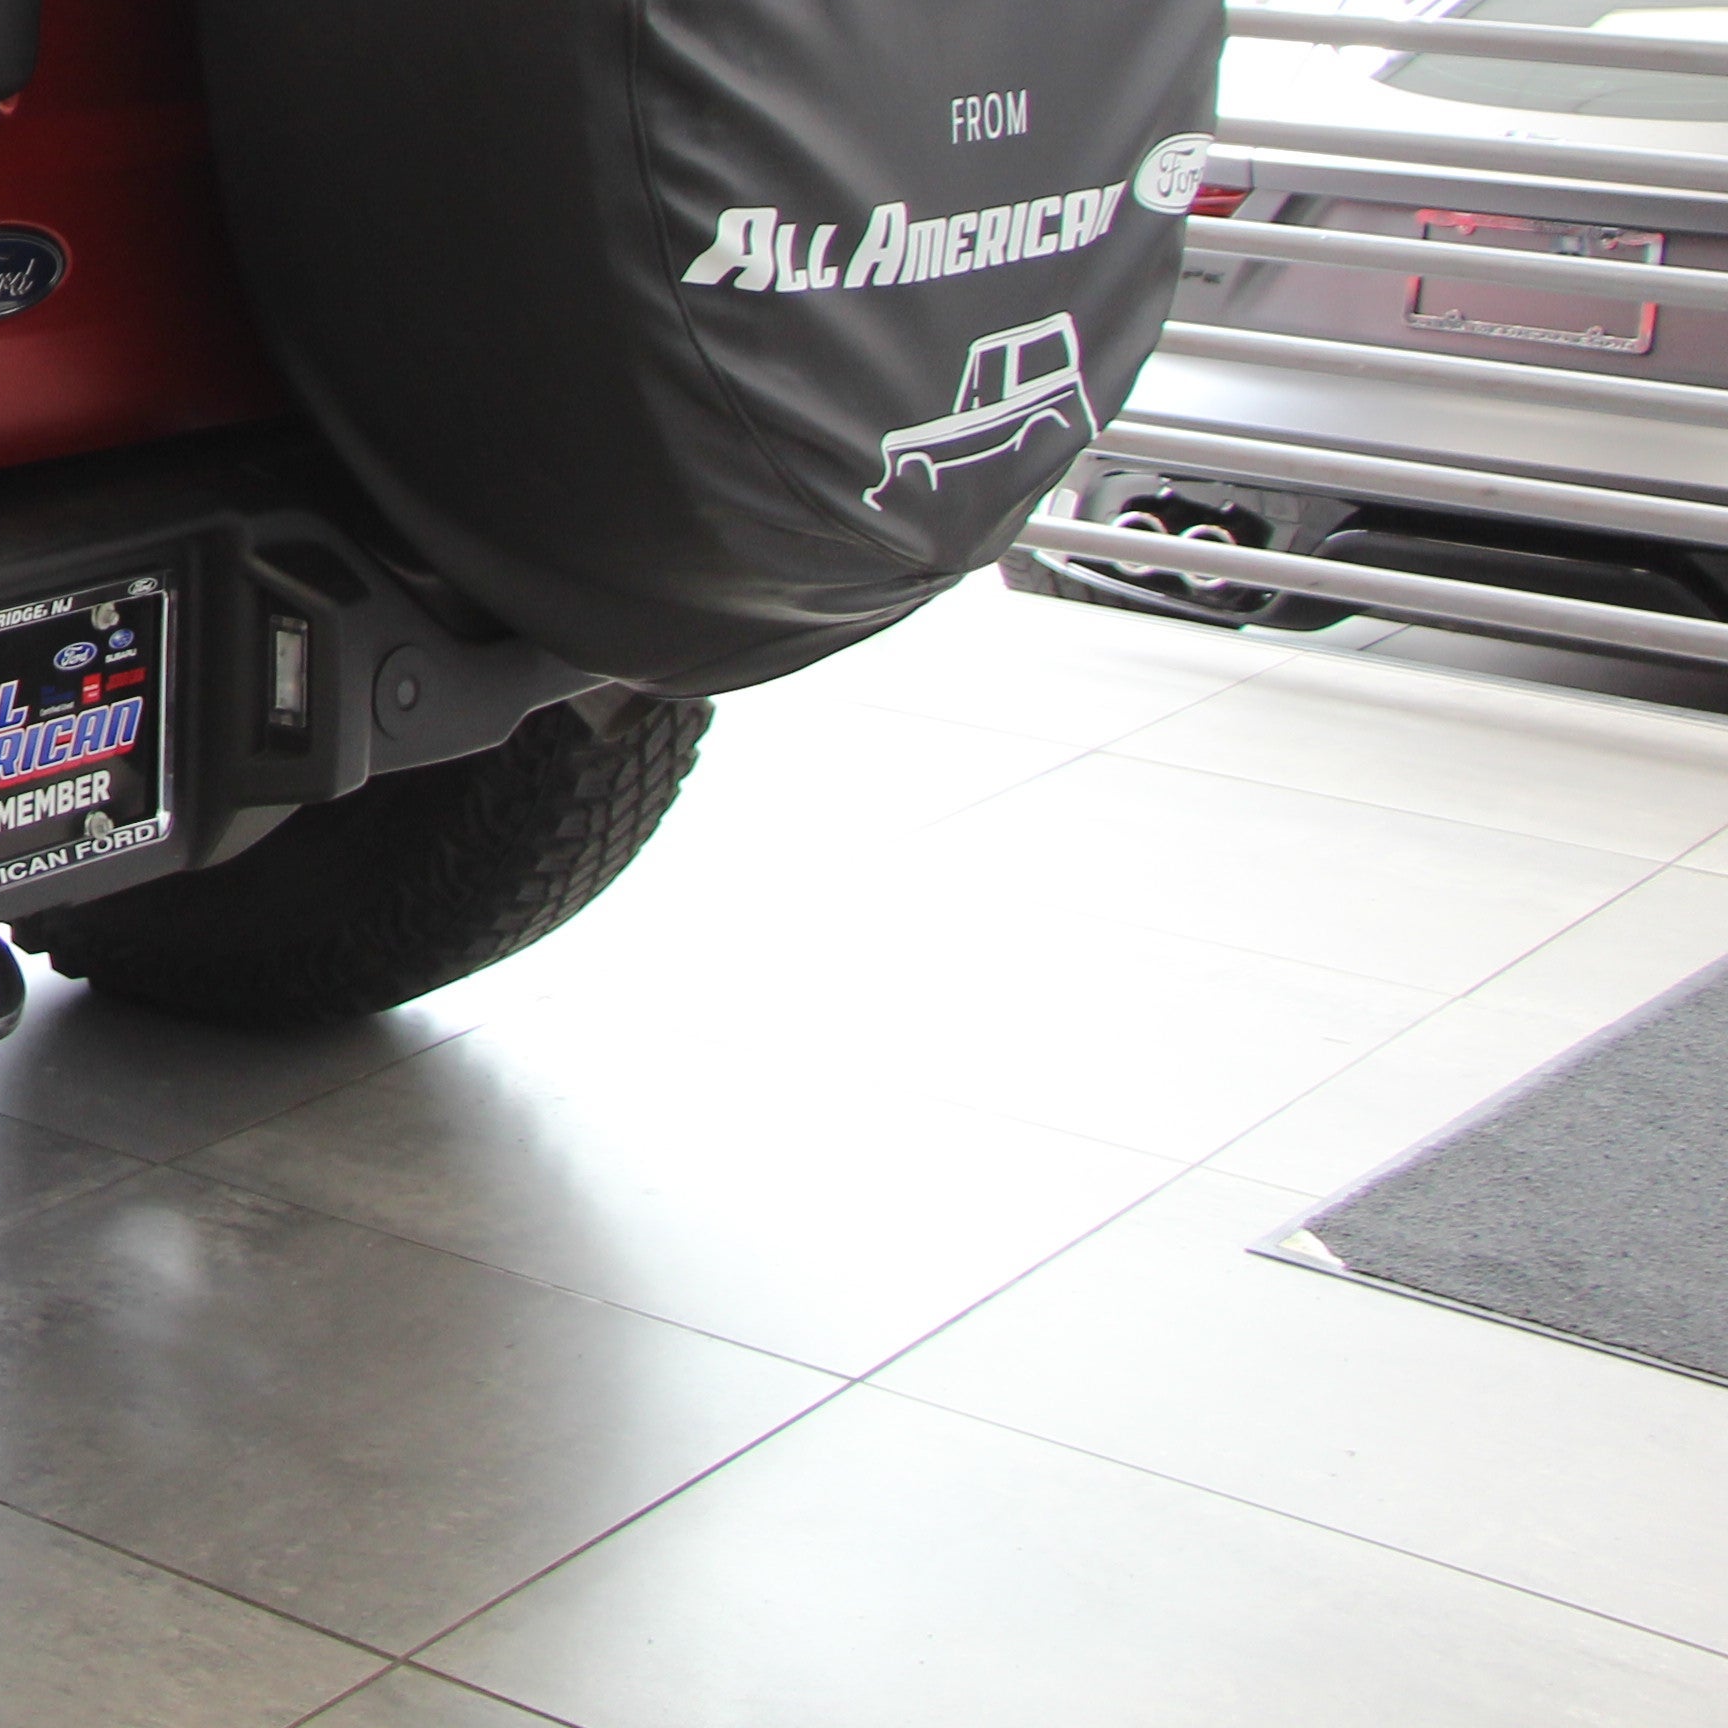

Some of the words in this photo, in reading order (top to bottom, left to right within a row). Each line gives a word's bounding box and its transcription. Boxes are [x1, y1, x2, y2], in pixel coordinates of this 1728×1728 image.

[950, 88, 1028, 144] FROM
[51, 596, 74, 616] NJ
[75, 824, 157, 860] FORD
